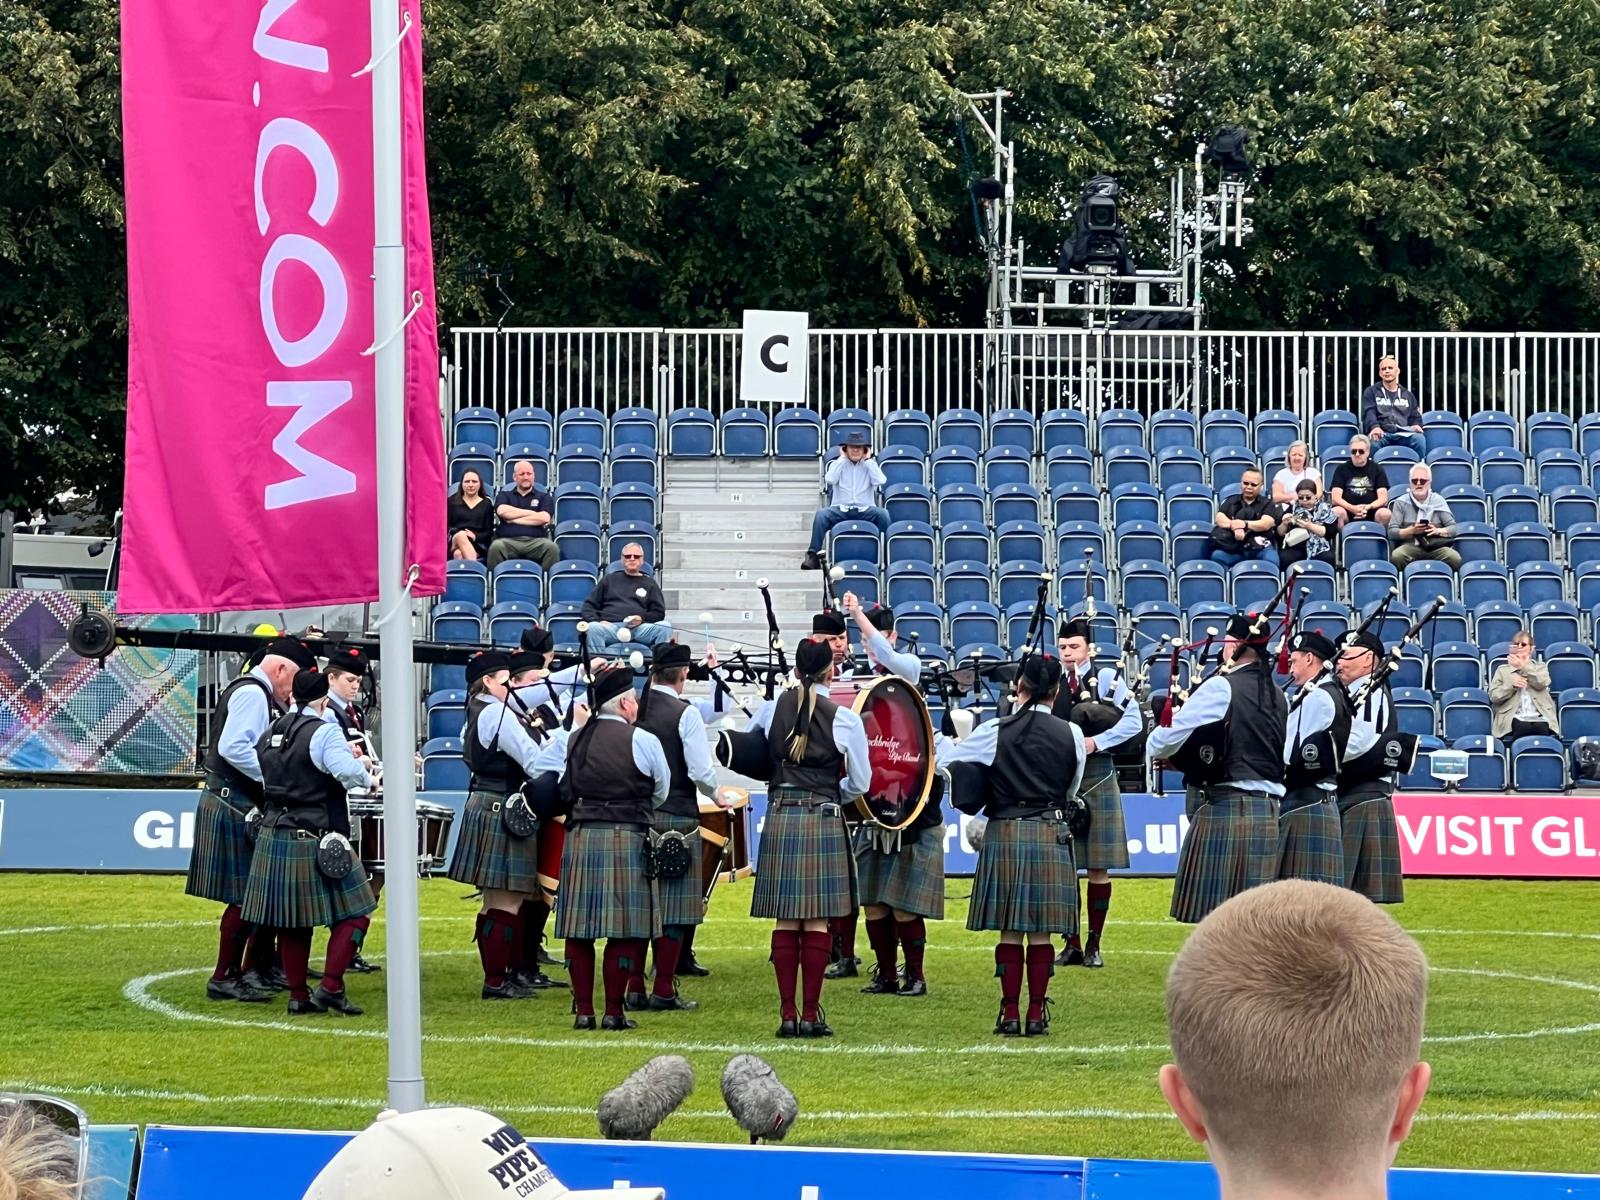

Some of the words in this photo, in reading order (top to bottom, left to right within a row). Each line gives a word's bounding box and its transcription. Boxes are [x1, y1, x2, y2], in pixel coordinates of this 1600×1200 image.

[760, 334, 789, 373] C
[868, 734, 900, 754] ockbridge
[1396, 815, 1523, 856] VISIT
[1531, 816, 1600, 857] GL
[488, 1149, 538, 1190] PIPE
